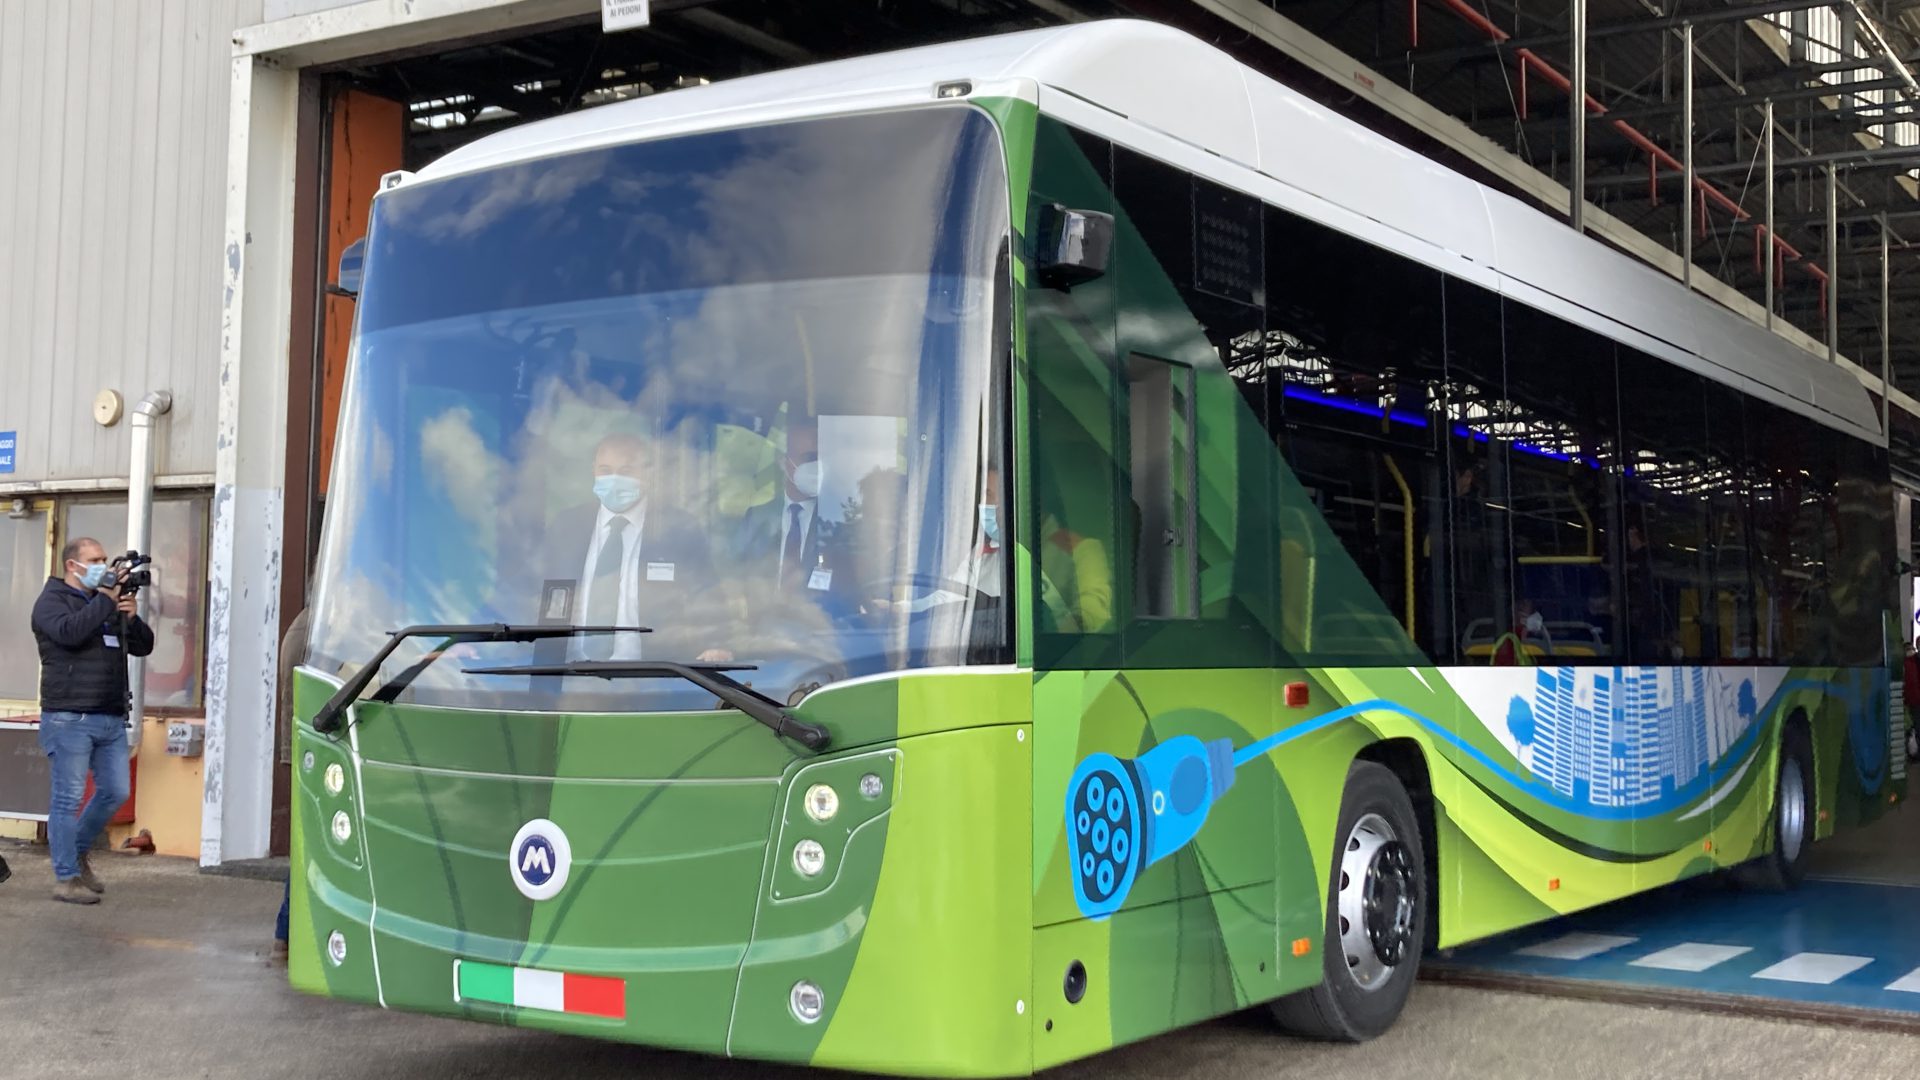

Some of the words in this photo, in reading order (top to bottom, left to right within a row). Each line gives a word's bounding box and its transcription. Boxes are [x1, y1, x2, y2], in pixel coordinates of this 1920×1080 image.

[610, 8, 617, 17] AI
[618, 4, 641, 16] PEDONI
[521, 845, 551, 874] M
